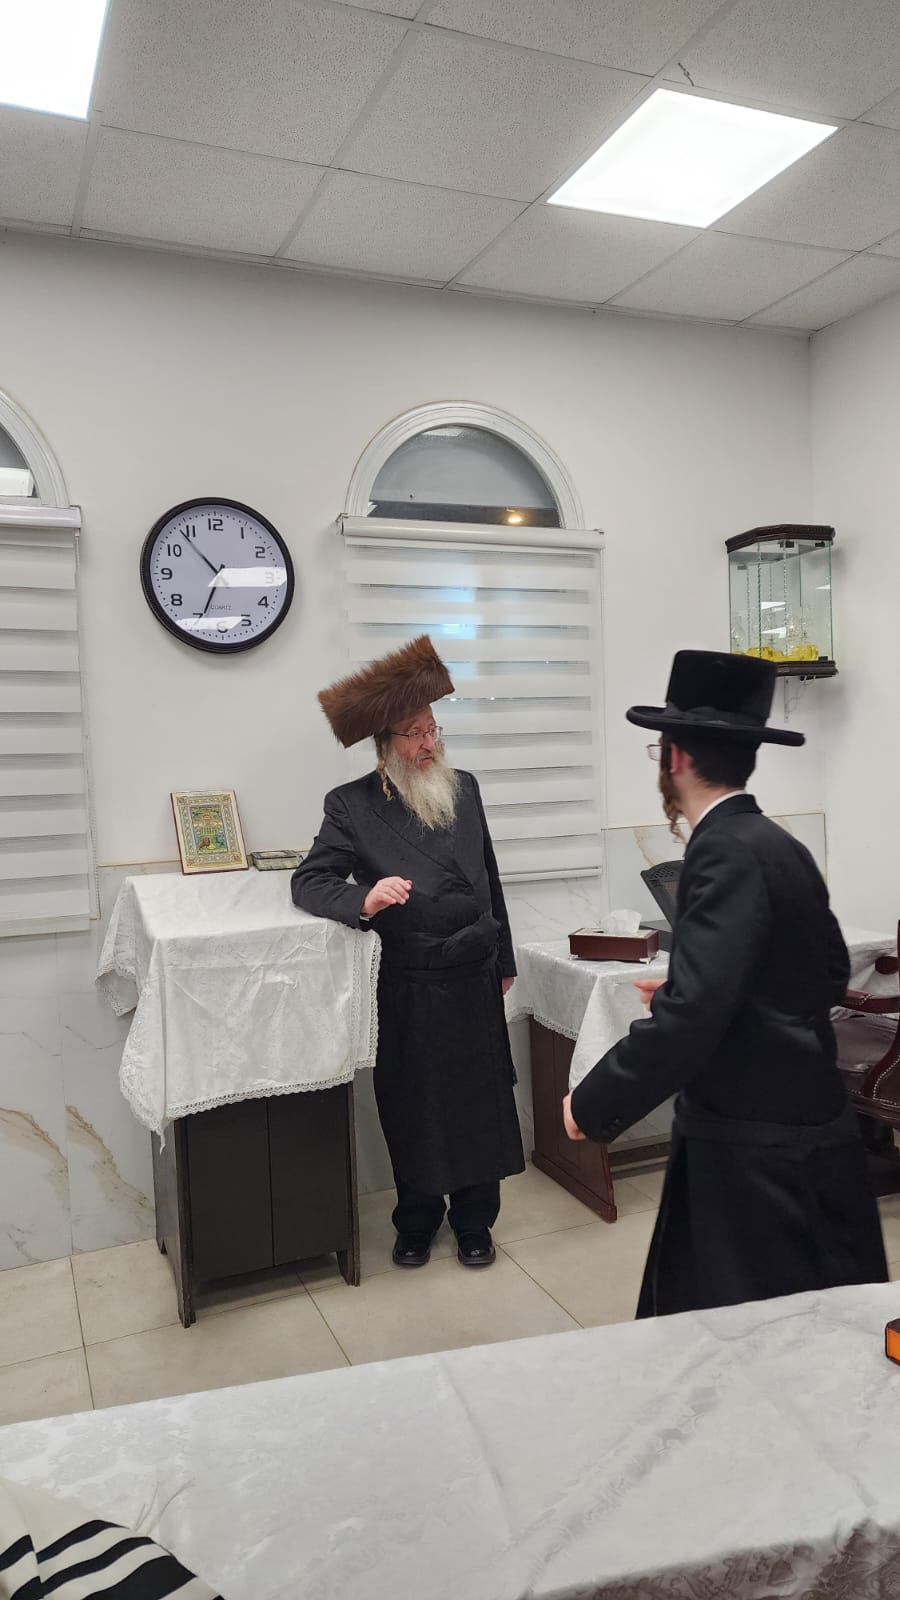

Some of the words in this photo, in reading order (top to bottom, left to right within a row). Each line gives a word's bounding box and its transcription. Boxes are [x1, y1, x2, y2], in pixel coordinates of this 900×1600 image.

[208, 518, 224, 531] 12
[186, 525, 196, 537] 11
[240, 527, 245, 539] 1
[167, 544, 182, 557] 10
[255, 546, 266, 558] 2
[161, 568, 172, 580] 9
[265, 572, 274, 584] 3
[171, 594, 182, 606] 8
[257, 596, 269, 608] 4
[192, 613, 204, 628] 7
[241, 614, 252, 626] 5
[217, 621, 228, 633] 6
